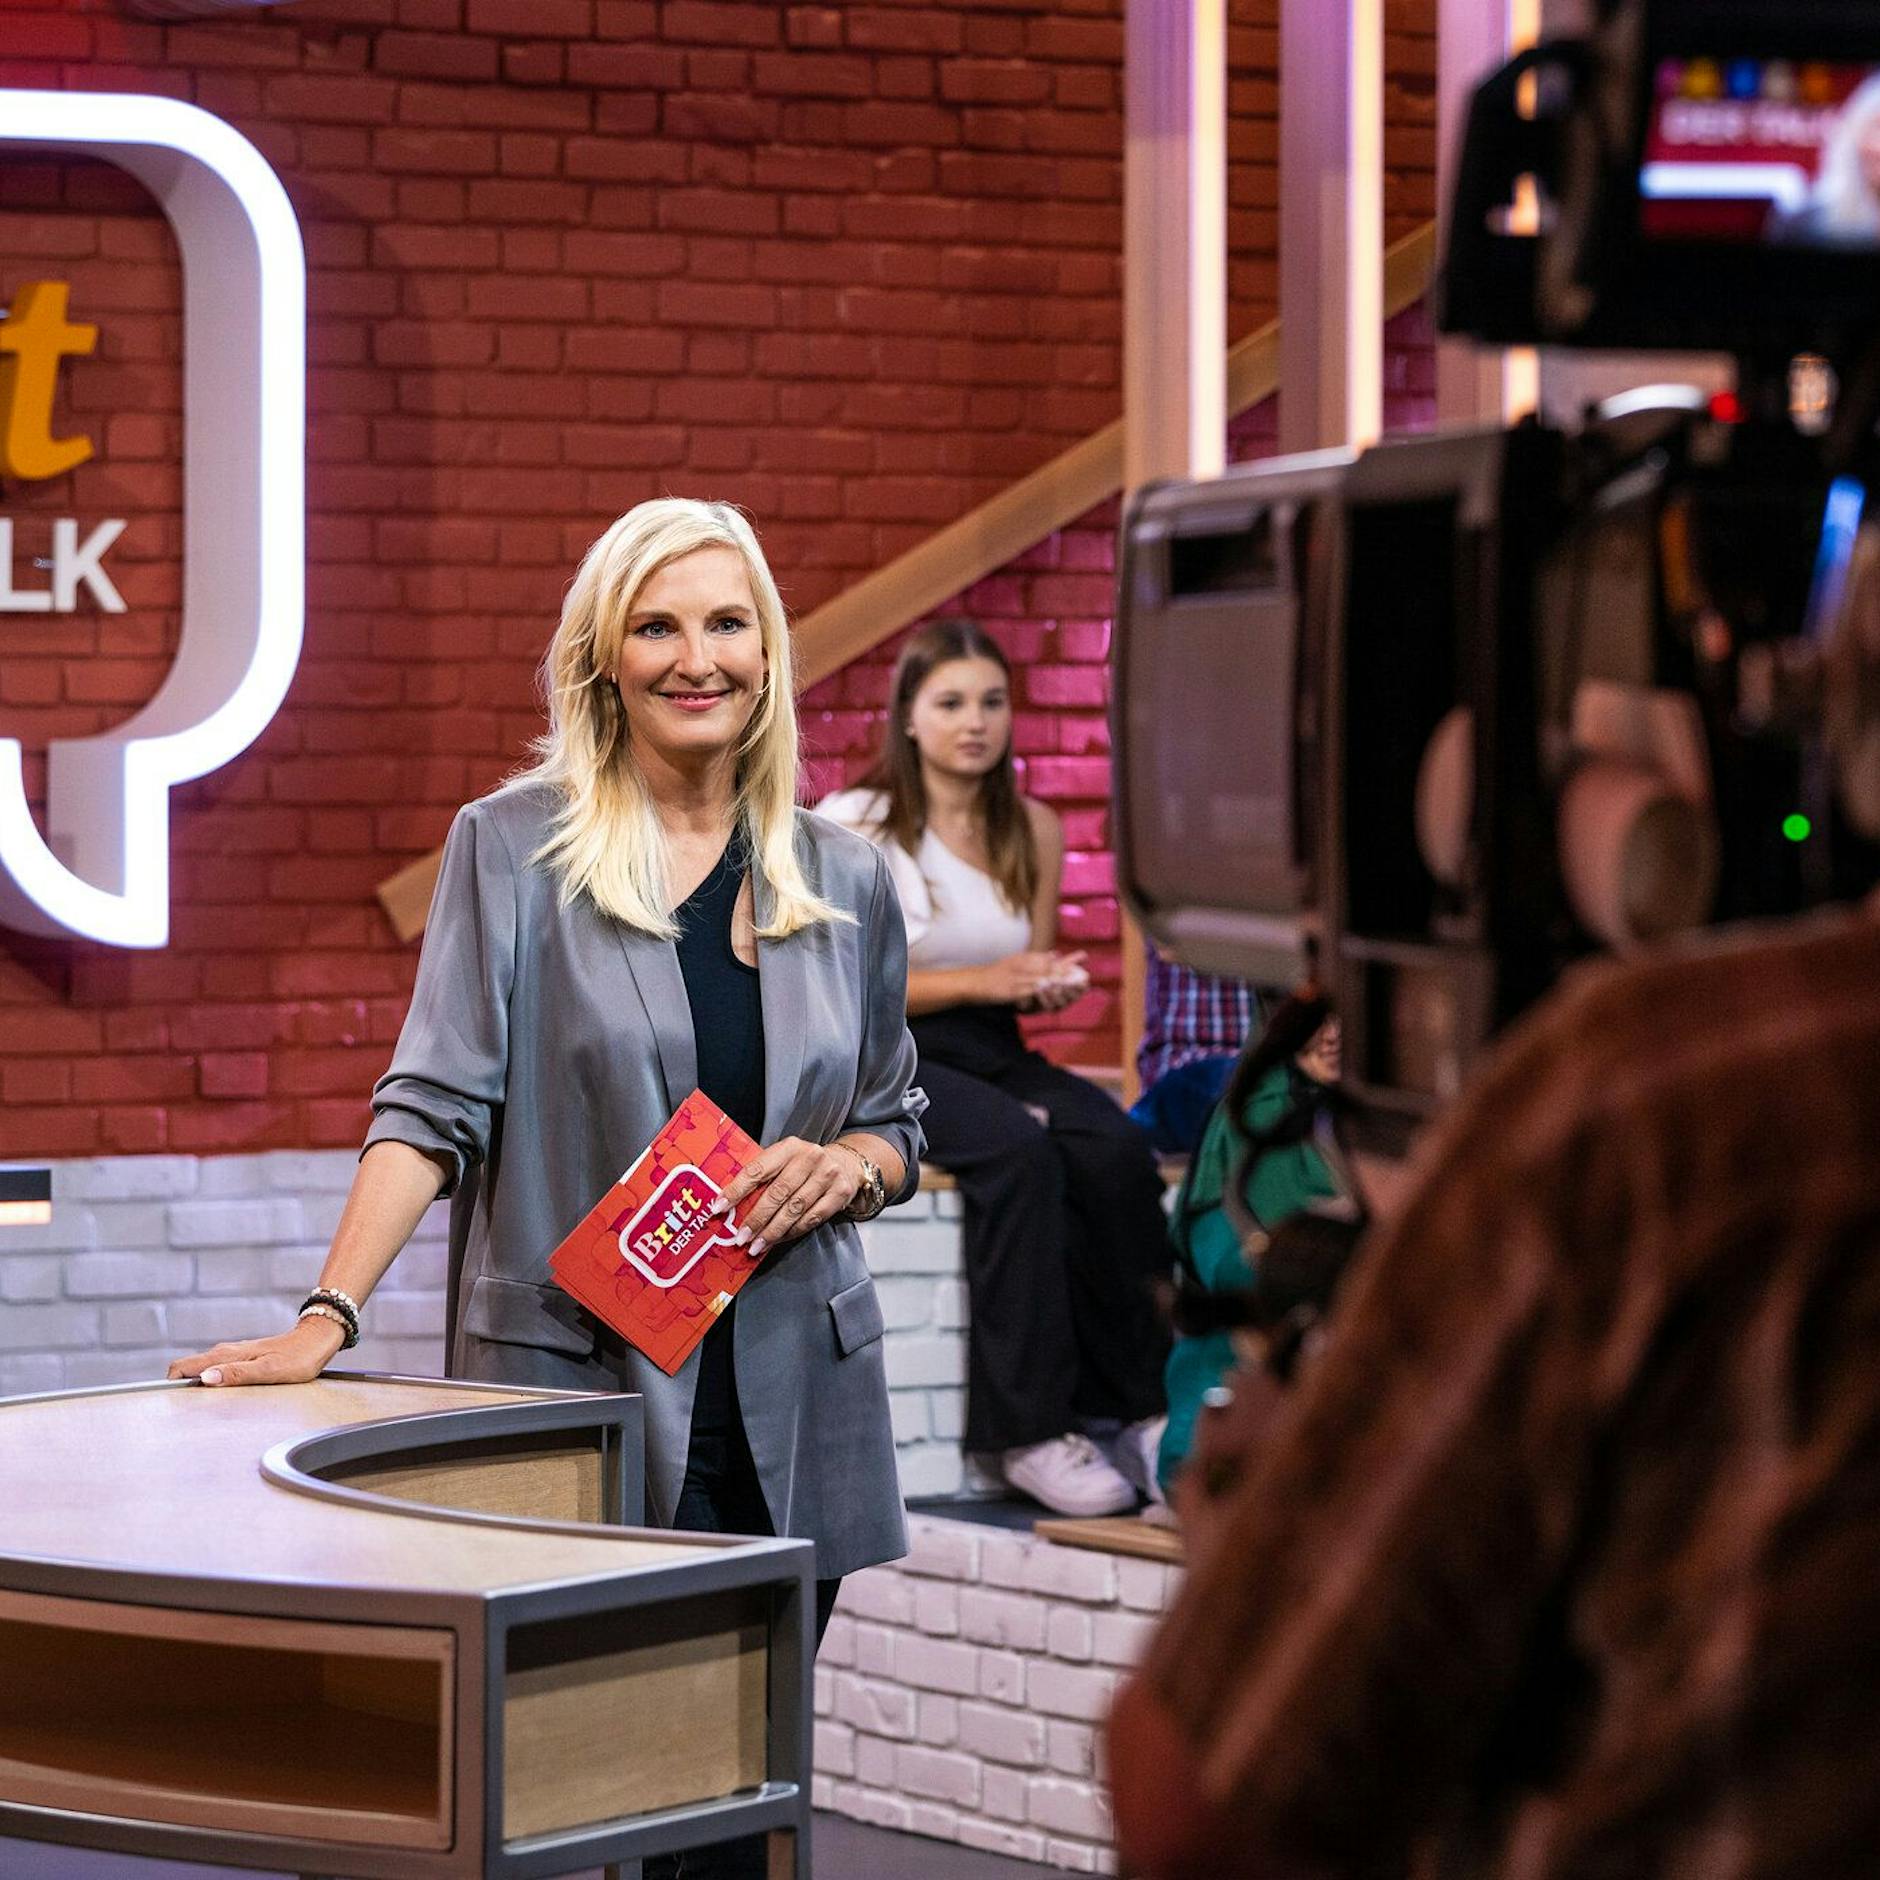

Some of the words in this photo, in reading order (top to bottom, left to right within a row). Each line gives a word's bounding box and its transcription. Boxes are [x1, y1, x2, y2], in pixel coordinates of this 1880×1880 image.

[0, 518, 128, 613] LK
[633, 1188, 702, 1262] Britt
[668, 1229, 695, 1255] DER
